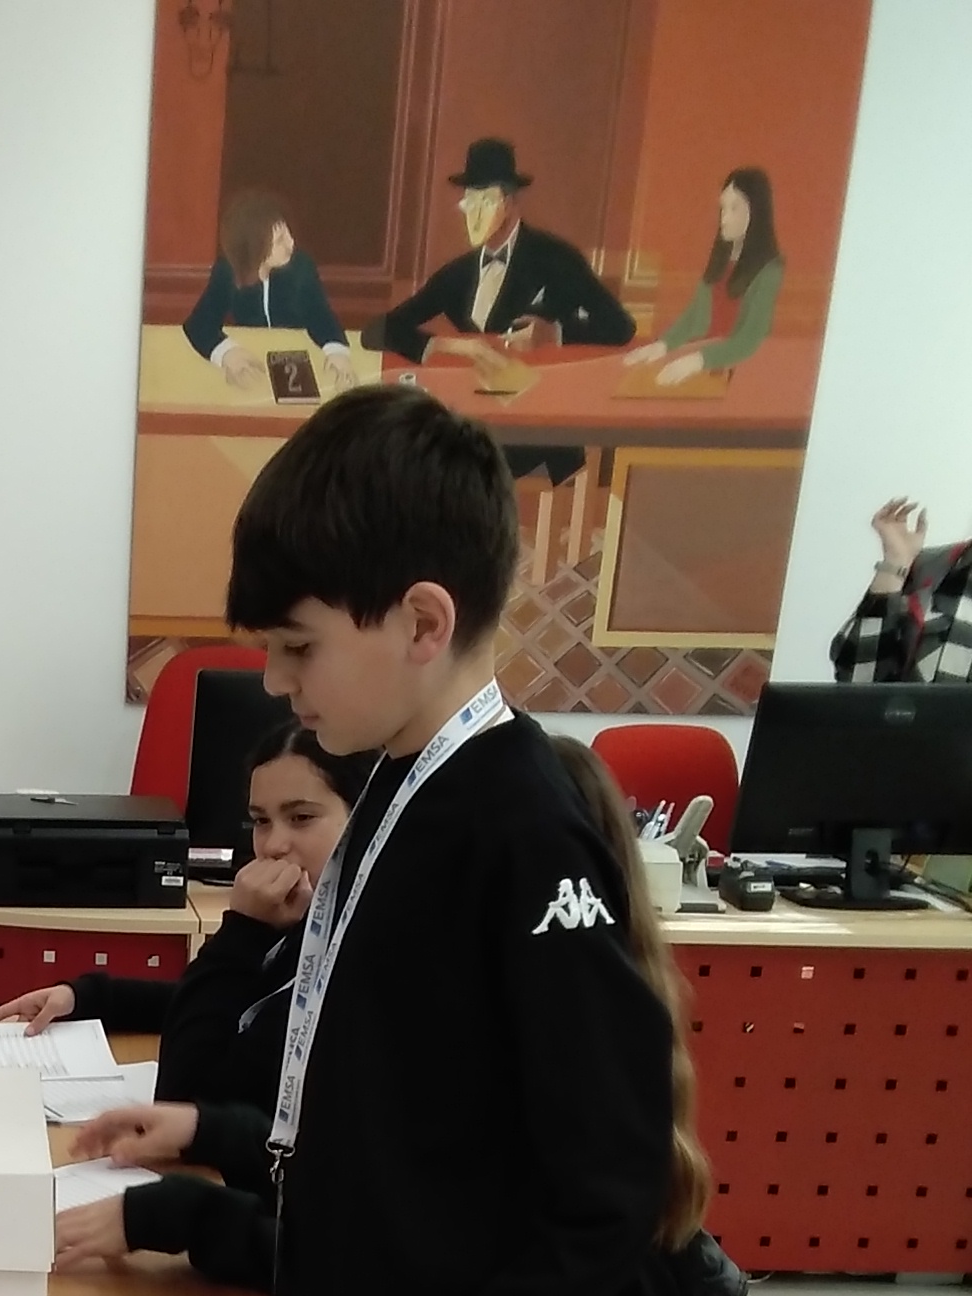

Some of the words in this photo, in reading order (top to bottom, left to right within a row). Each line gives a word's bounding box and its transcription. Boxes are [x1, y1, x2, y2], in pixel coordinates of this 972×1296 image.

[284, 362, 303, 392] 2
[414, 735, 450, 773] EMSA
[313, 880, 331, 920] EMSA
[298, 953, 317, 994] EMSA
[280, 1075, 296, 1110] EMSA
